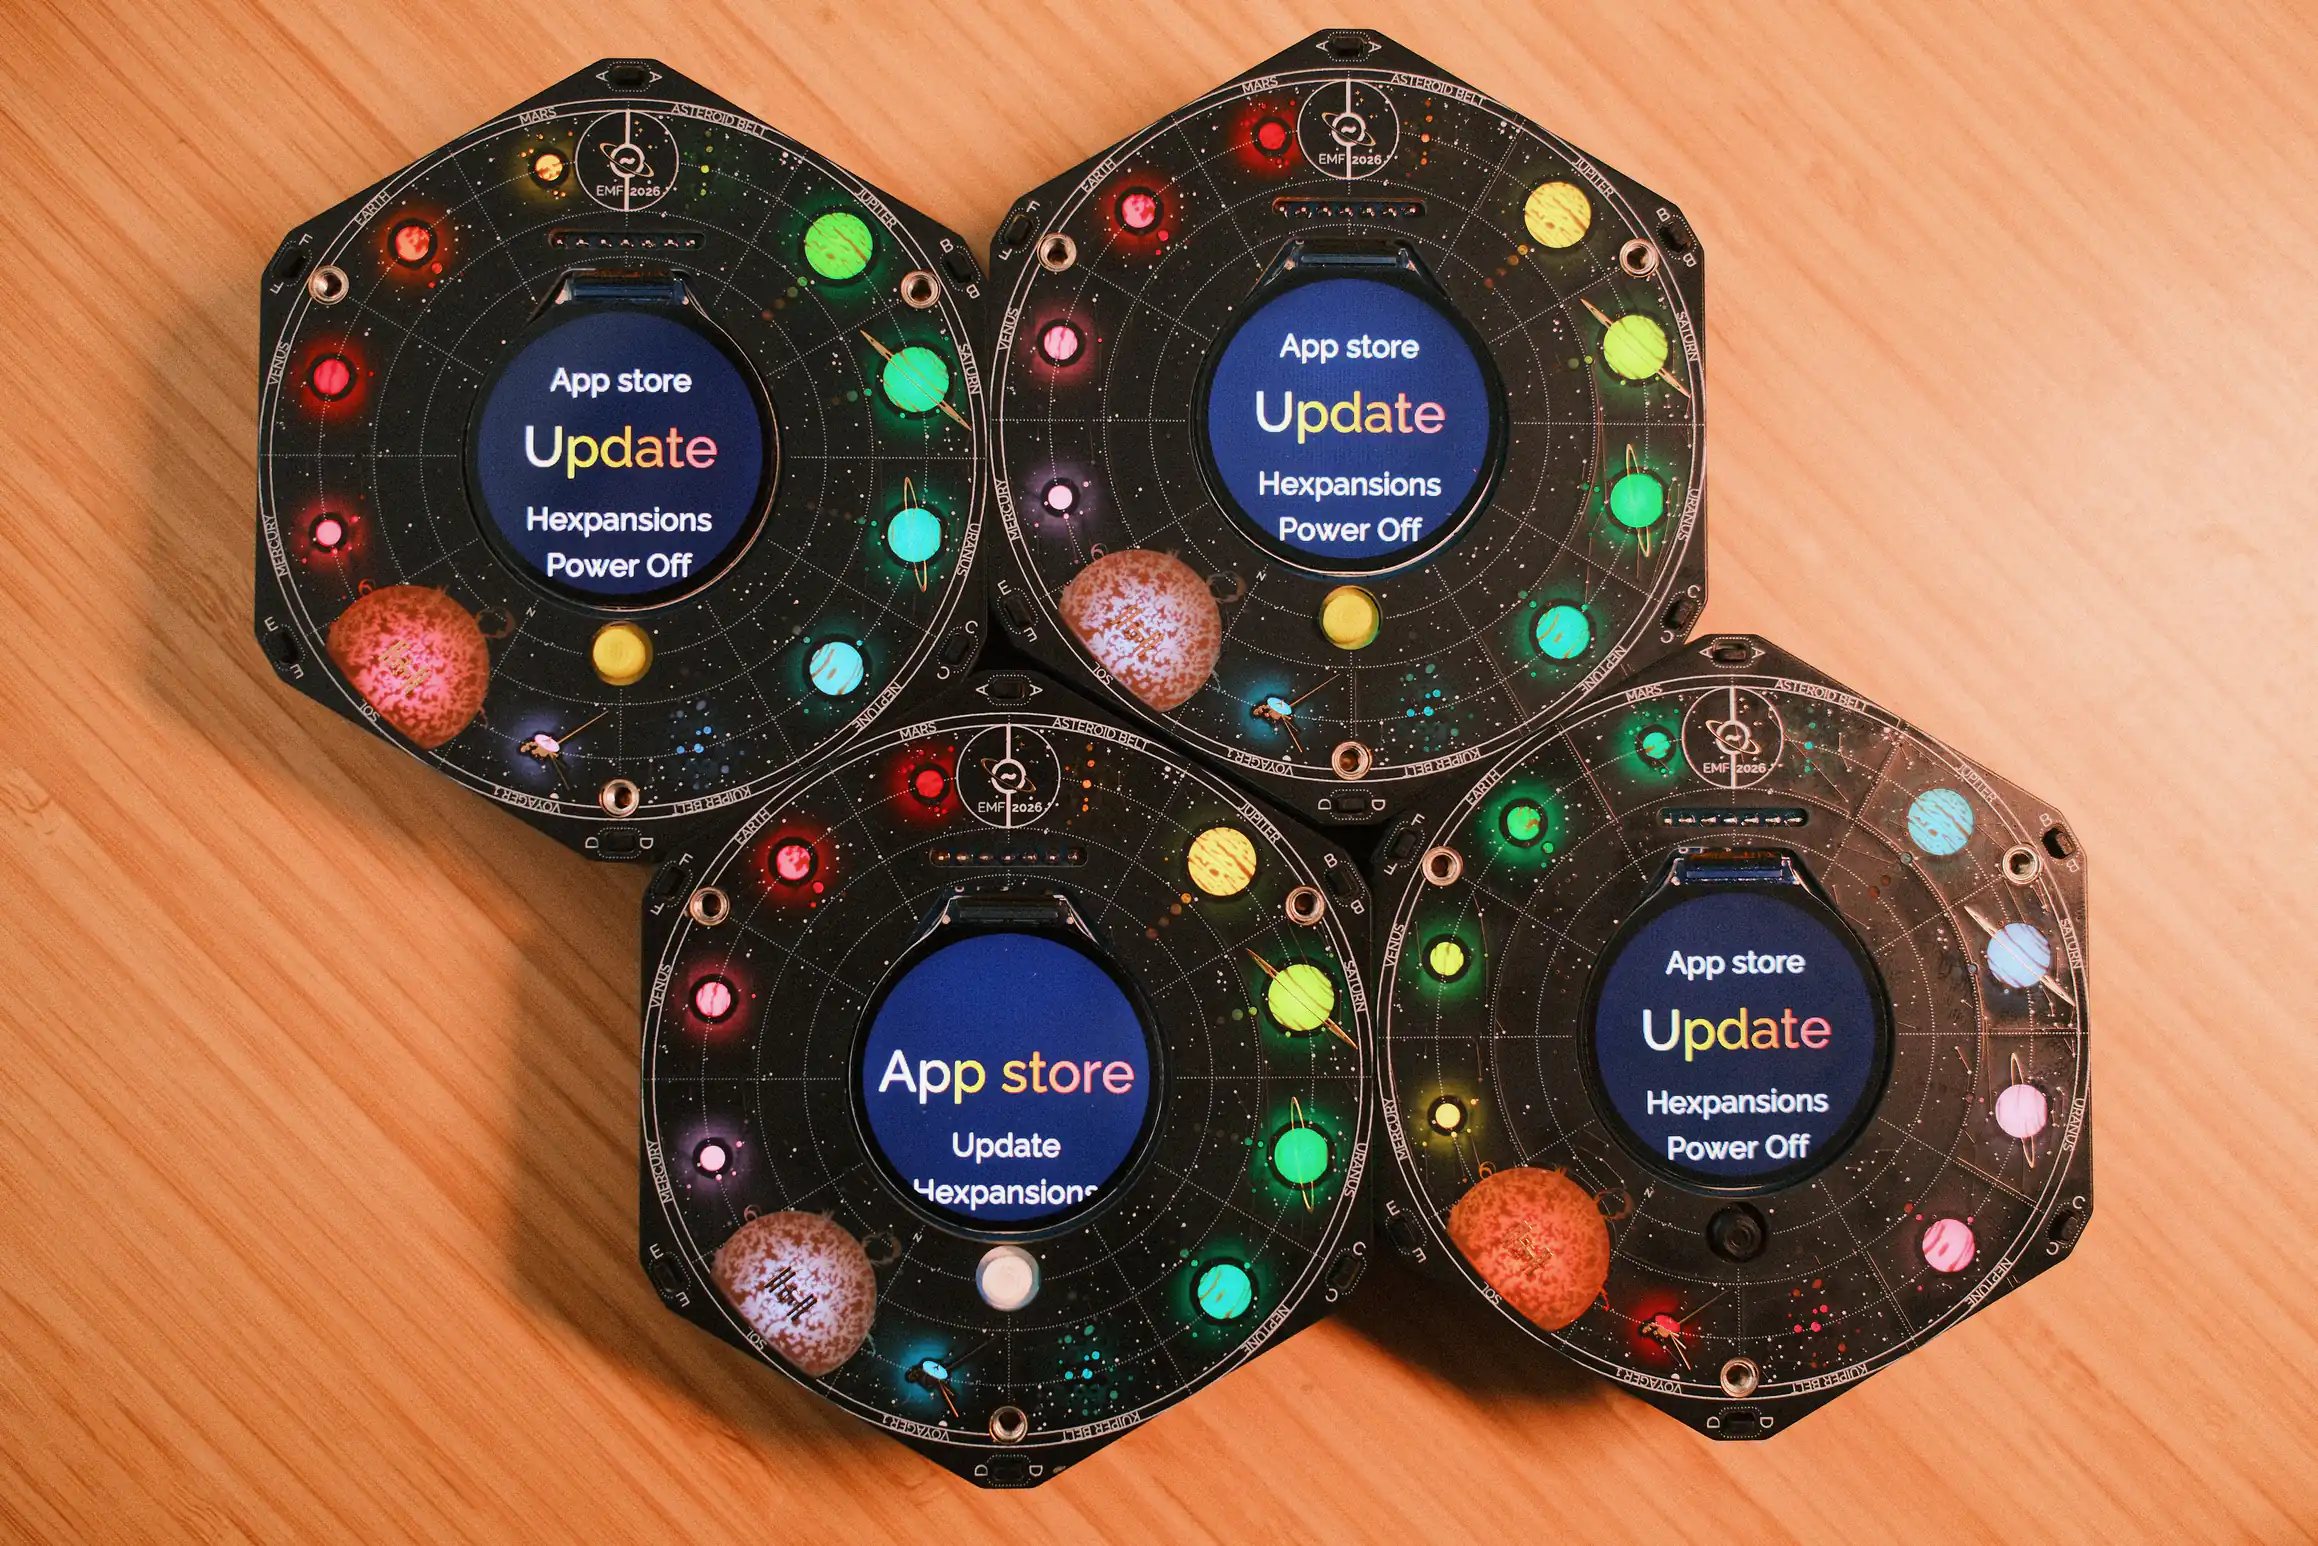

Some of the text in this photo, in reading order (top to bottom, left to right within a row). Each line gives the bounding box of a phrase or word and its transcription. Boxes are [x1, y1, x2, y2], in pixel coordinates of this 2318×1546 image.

[1316, 41, 1327, 51] A
[1370, 41, 1381, 51] A
[596, 71, 607, 82] A
[650, 71, 662, 82] A
[1241, 76, 1278, 93] MARS
[1391, 73, 1486, 106] ASTEROID BELT
[519, 108, 557, 124] MARS
[671, 104, 767, 136] ASTEROID BELT
[1318, 153, 1382, 166] EMF 2026
[1081, 158, 1116, 193] EARTH
[1571, 156, 1614, 197] JUPITER
[596, 185, 660, 197] EMF 2026
[354, 190, 392, 226] EARTH
[854, 188, 897, 229] JUPITER
[1026, 200, 1040, 213] F
[1656, 208, 1670, 221] B
[299, 234, 313, 246] F
[940, 239, 953, 253] B
[997, 248, 1011, 260] F
[1683, 252, 1697, 267] B
[270, 280, 283, 294] F
[967, 285, 980, 299] B
[998, 307, 1019, 350] VENUS
[1675, 311, 1698, 362] SATURN
[1279, 333, 1419, 364] App store
[269, 342, 289, 386] VENUS
[957, 343, 980, 395] SATURN
[550, 367, 692, 398] App store
[1256, 390, 1445, 443] Update
[525, 424, 717, 478] Update
[1258, 472, 1441, 502] Hexpansions
[994, 478, 1020, 541] MERCURY
[1677, 489, 1698, 541] URANUS
[526, 507, 712, 537] Hexpansions
[1279, 517, 1422, 541] Power Off
[263, 514, 288, 576] MERCURY
[956, 523, 980, 577] URANUS
[546, 553, 693, 578] Power Off
[998, 580, 1011, 595] E
[1688, 585, 1701, 599] C
[264, 617, 278, 630] E
[965, 620, 978, 634] C
[1024, 628, 1037, 643] E
[1660, 630, 1673, 644] C
[1700, 647, 1711, 658] A
[1753, 647, 1765, 657] A
[289, 663, 303, 679] E
[937, 664, 950, 680] C
[1092, 663, 1113, 687] SOL
[1579, 645, 1626, 695] NEPTUNE
[976, 684, 987, 695] A
[1030, 684, 1042, 695] A
[1625, 684, 1663, 701] MARS
[1774, 679, 1868, 713] ASTEROID BELT
[358, 699, 380, 722] SOL
[852, 682, 901, 731] NEPTUNE
[899, 720, 937, 738] MARS
[1052, 717, 1150, 750] ASTEROID BELT
[1235, 749, 1293, 775] VOYAGER
[1404, 748, 1479, 777] KUIPER BELT
[1703, 762, 1767, 774] EMF 2026
[1464, 769, 1501, 806] EARTH
[1954, 763, 1997, 804] JUPITER
[502, 786, 561, 813] VOYAGER
[673, 787, 752, 815] KUIPER BELT
[977, 801, 1043, 813] EMF 2026
[1318, 798, 1331, 810] D
[1372, 798, 1385, 810] D
[733, 809, 771, 846] EARTH
[1237, 802, 1281, 844] JUPITER
[1412, 813, 1425, 826] F
[2040, 813, 2052, 826] B
[585, 837, 599, 849] D
[640, 836, 654, 849] D
[679, 852, 693, 865] F
[1324, 854, 1338, 868] B
[2066, 858, 2079, 872] B
[1383, 863, 1397, 877] F
[651, 903, 665, 916] F
[1351, 900, 1364, 915] B
[1382, 923, 1405, 968] VENUS
[2060, 918, 2082, 969] SATURN
[1665, 950, 1805, 981] App store
[651, 963, 672, 1008] VENUS
[1344, 961, 1366, 1013] SATURN
[1642, 1008, 1831, 1061] Update
[879, 1049, 1134, 1104] App store
[1646, 1090, 1829, 1119] Hexpansions
[1382, 1098, 1407, 1160] MERCURY
[2065, 1097, 2086, 1151] URANUS
[952, 1132, 1061, 1163] Update
[1667, 1134, 1811, 1160] Power Off
[648, 1141, 673, 1203] MERCURY
[1343, 1143, 1366, 1197] URANUS
[1386, 1200, 1400, 1215] E
[2072, 1196, 2085, 1210] C
[650, 1243, 663, 1258] E
[1352, 1241, 1366, 1255] C
[1412, 1247, 1426, 1263] E
[2045, 1241, 2058, 1256] C
[1482, 1283, 1502, 1305] SOL
[1965, 1259, 2013, 1307] NEPTUNE
[676, 1291, 690, 1307] E
[1325, 1288, 1338, 1303] C
[746, 1328, 767, 1350] SOL
[1242, 1304, 1291, 1353] NEPTUNE
[1626, 1368, 1682, 1394] VOYAGER
[1792, 1364, 1868, 1393] KUIPER BELT
[890, 1416, 950, 1441] VOYAGER
[1063, 1413, 1141, 1441] KUIPER BELT
[1706, 1416, 1720, 1428] D
[1760, 1415, 1774, 1428] D
[974, 1465, 987, 1477] D
[1029, 1464, 1042, 1477] D
